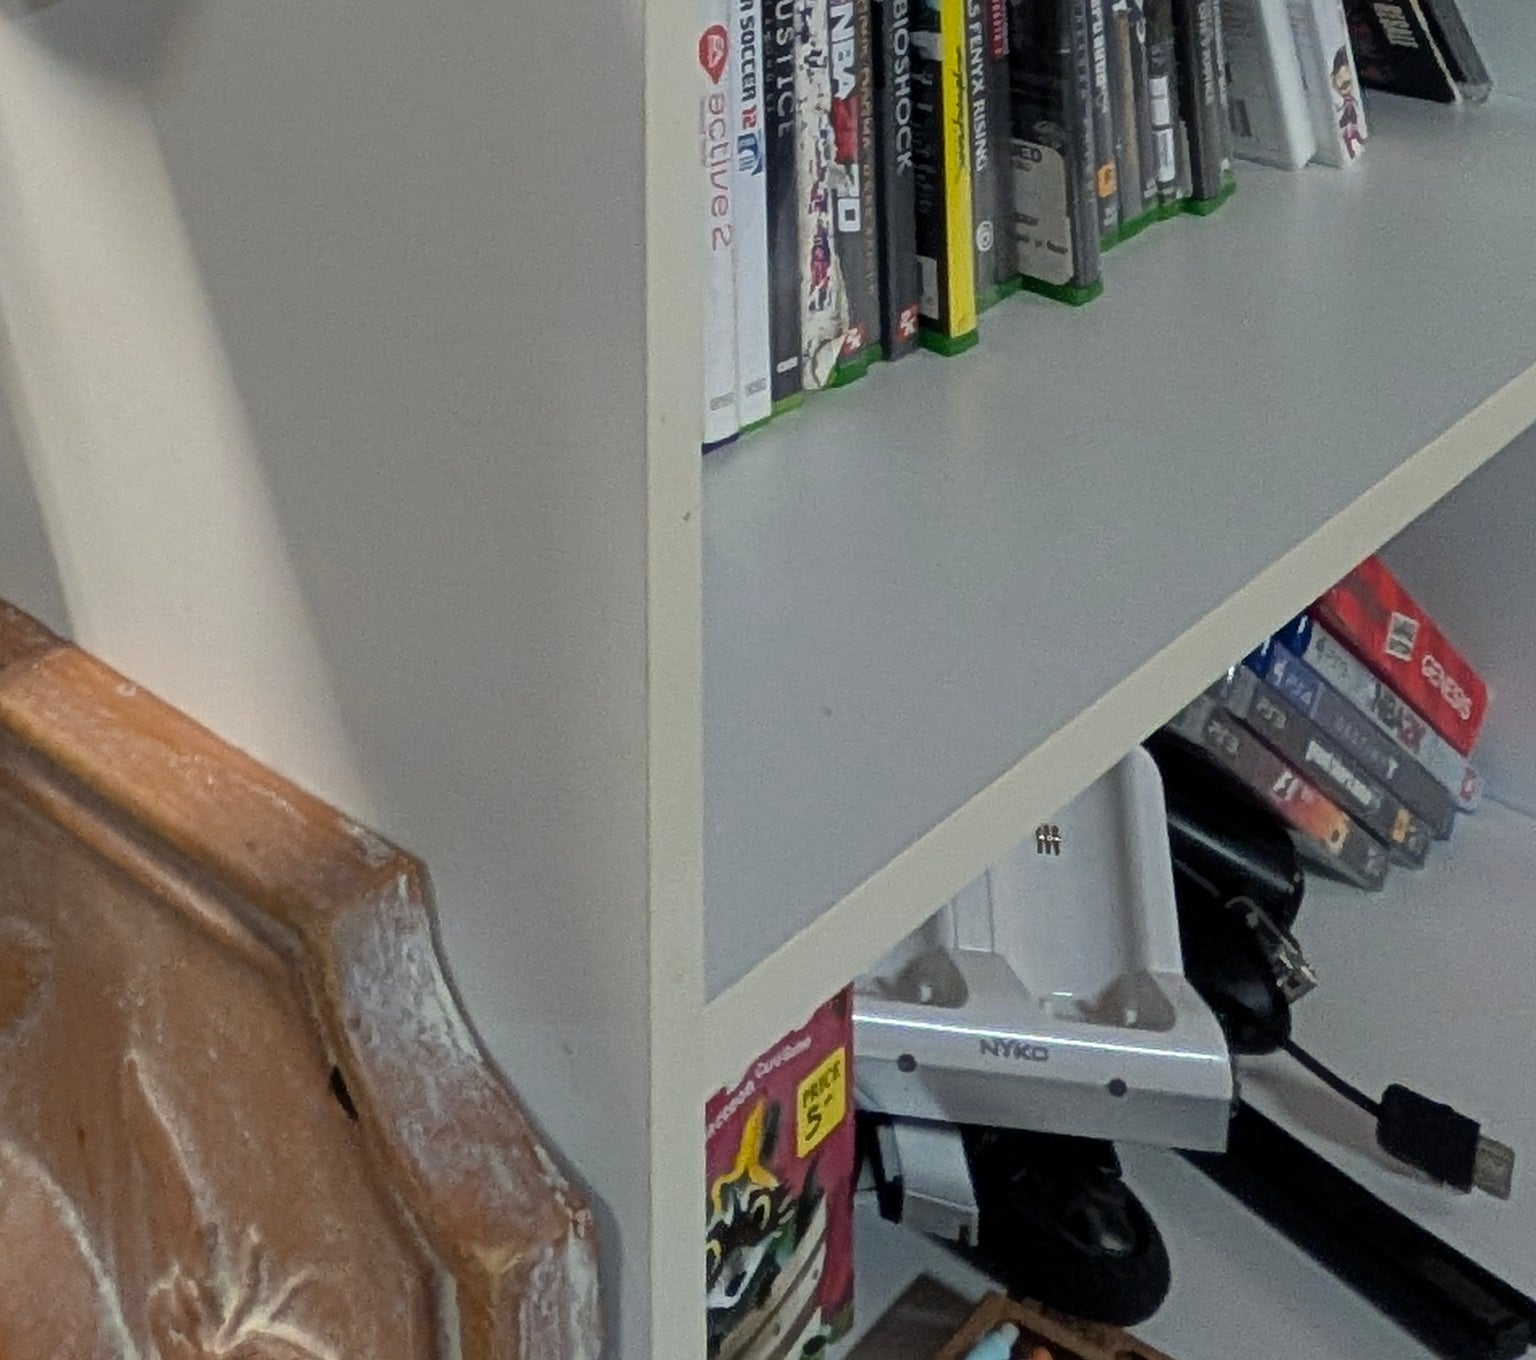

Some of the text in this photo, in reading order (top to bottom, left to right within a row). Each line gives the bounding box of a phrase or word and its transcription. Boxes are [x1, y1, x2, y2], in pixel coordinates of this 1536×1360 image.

[738, 14, 757, 103] SOCCER
[830, 2, 856, 100] NBA
[968, 21, 985, 95] FENYX
[741, 104, 758, 130] 12
[973, 96, 990, 173] RISING
[708, 93, 734, 218] active
[711, 225, 732, 251] 2
[979, 1037, 1050, 1063] NYKO
